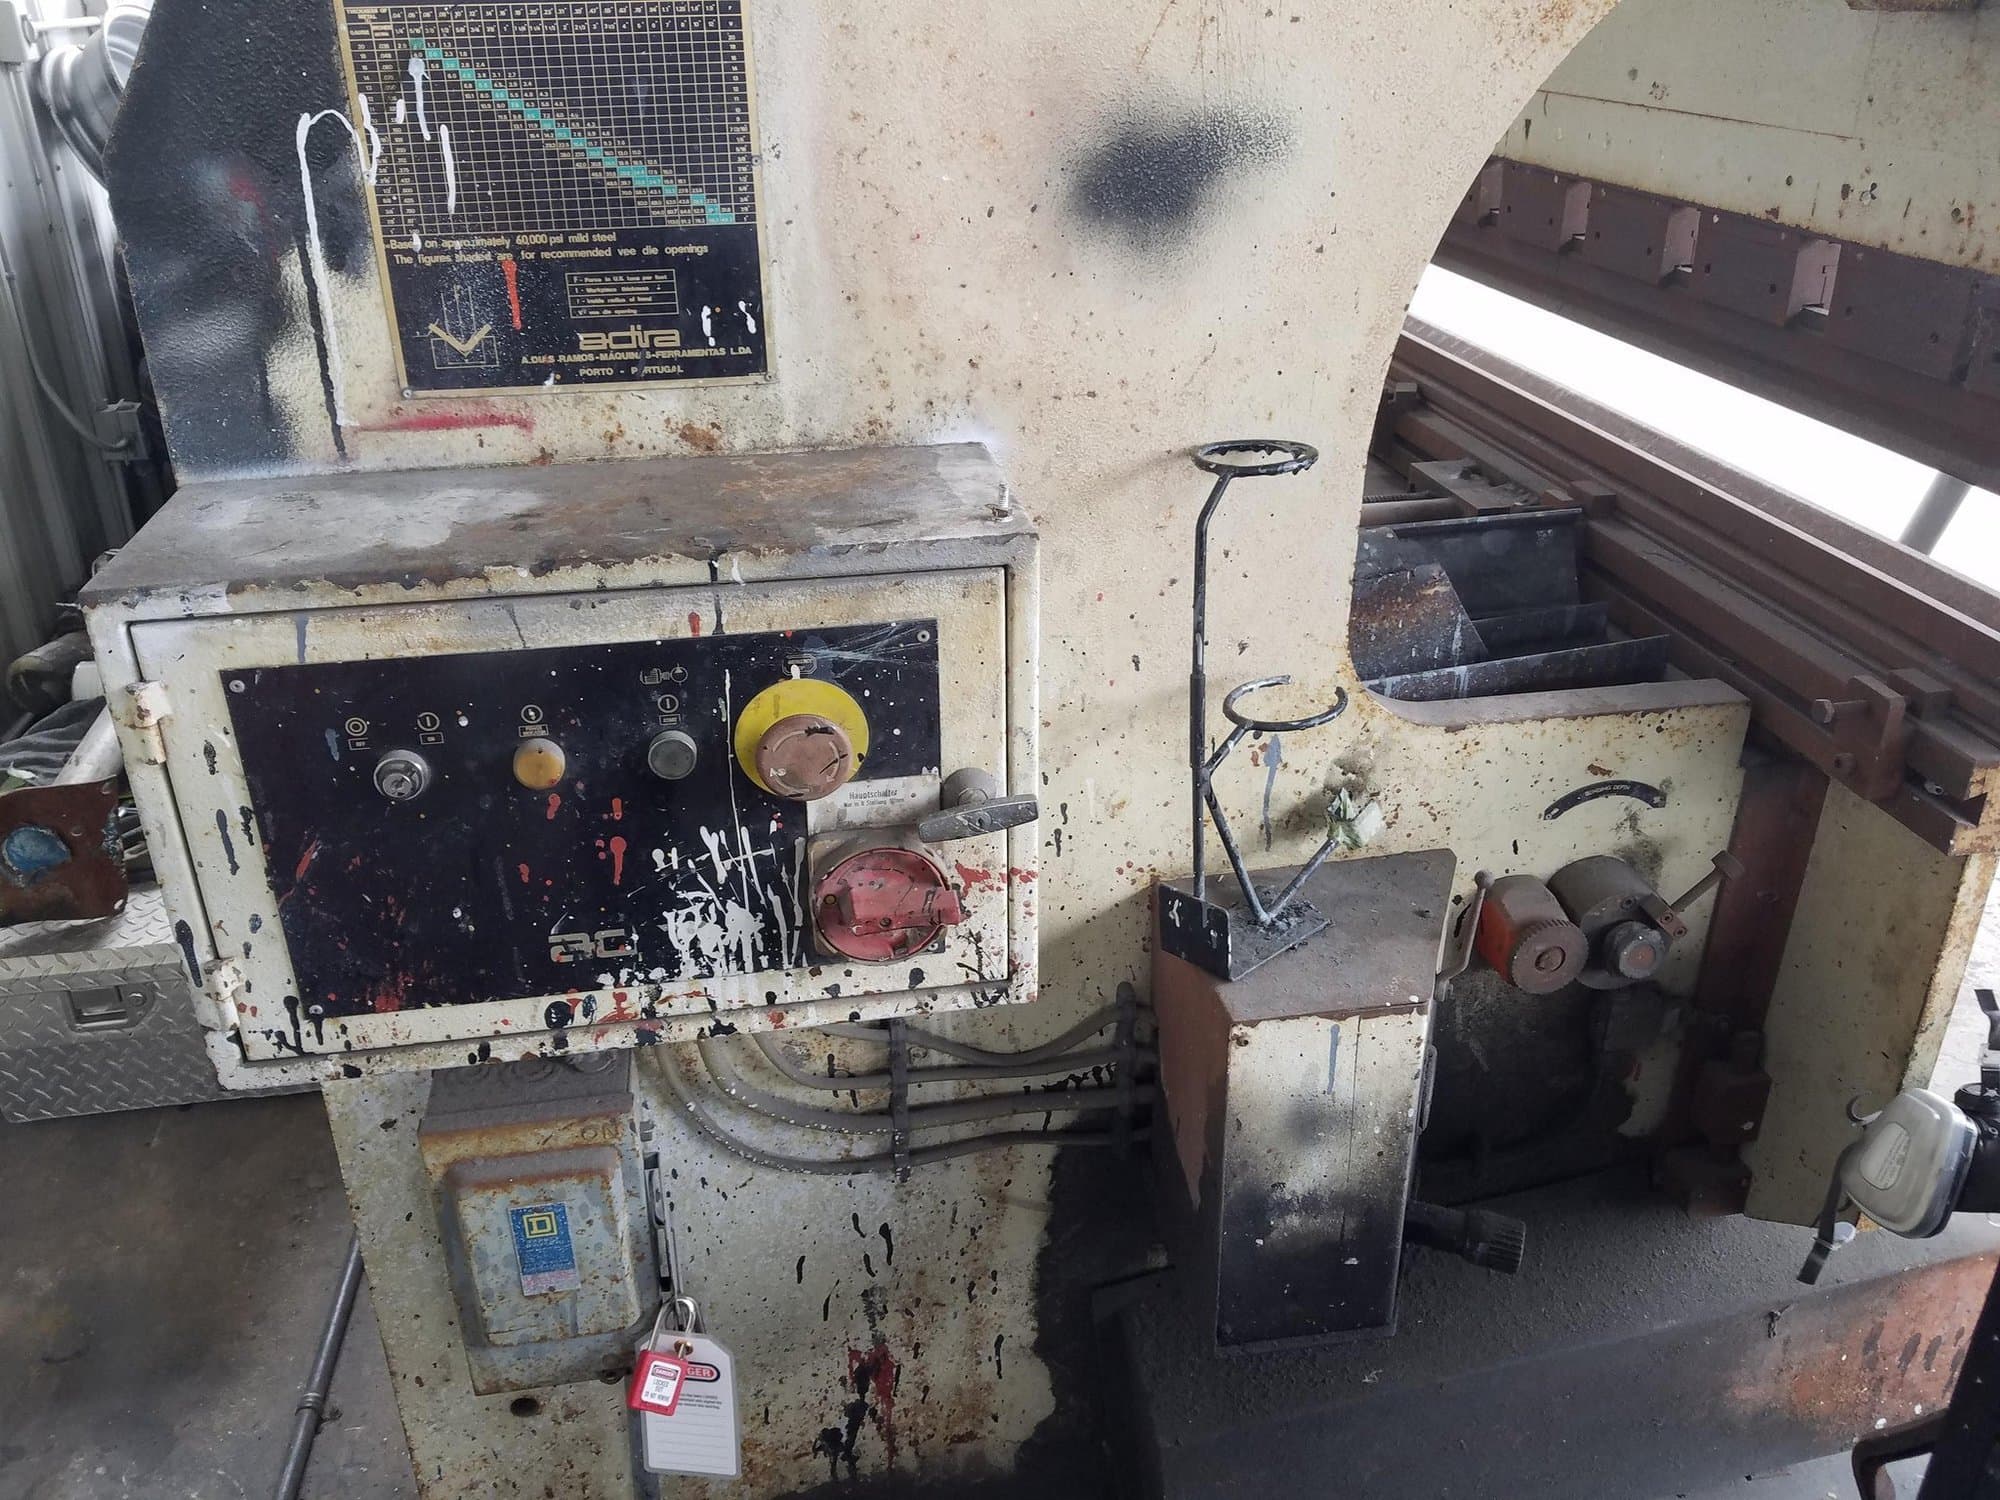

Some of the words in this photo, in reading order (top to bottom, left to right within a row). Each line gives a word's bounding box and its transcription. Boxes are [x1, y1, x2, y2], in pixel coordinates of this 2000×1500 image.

[390, 238, 419, 250] Base
[424, 239, 438, 248] on
[441, 236, 510, 250] aproimately
[515, 234, 548, 246] 60,000
[550, 234, 563, 246] psi
[568, 233, 589, 243] mild
[592, 232, 617, 242] steel
[394, 253, 413, 265] The
[418, 252, 451, 266] figures
[455, 251, 492, 264] shaded
[497, 252, 513, 261] are
[520, 250, 535, 260] for
[540, 247, 612, 259] recommended
[617, 247, 637, 256] vee
[642, 245, 658, 255] die
[664, 244, 709, 256] openings
[579, 324, 681, 350] adira
[579, 367, 614, 376] PORTO
[631, 365, 684, 376] PRTUGAL
